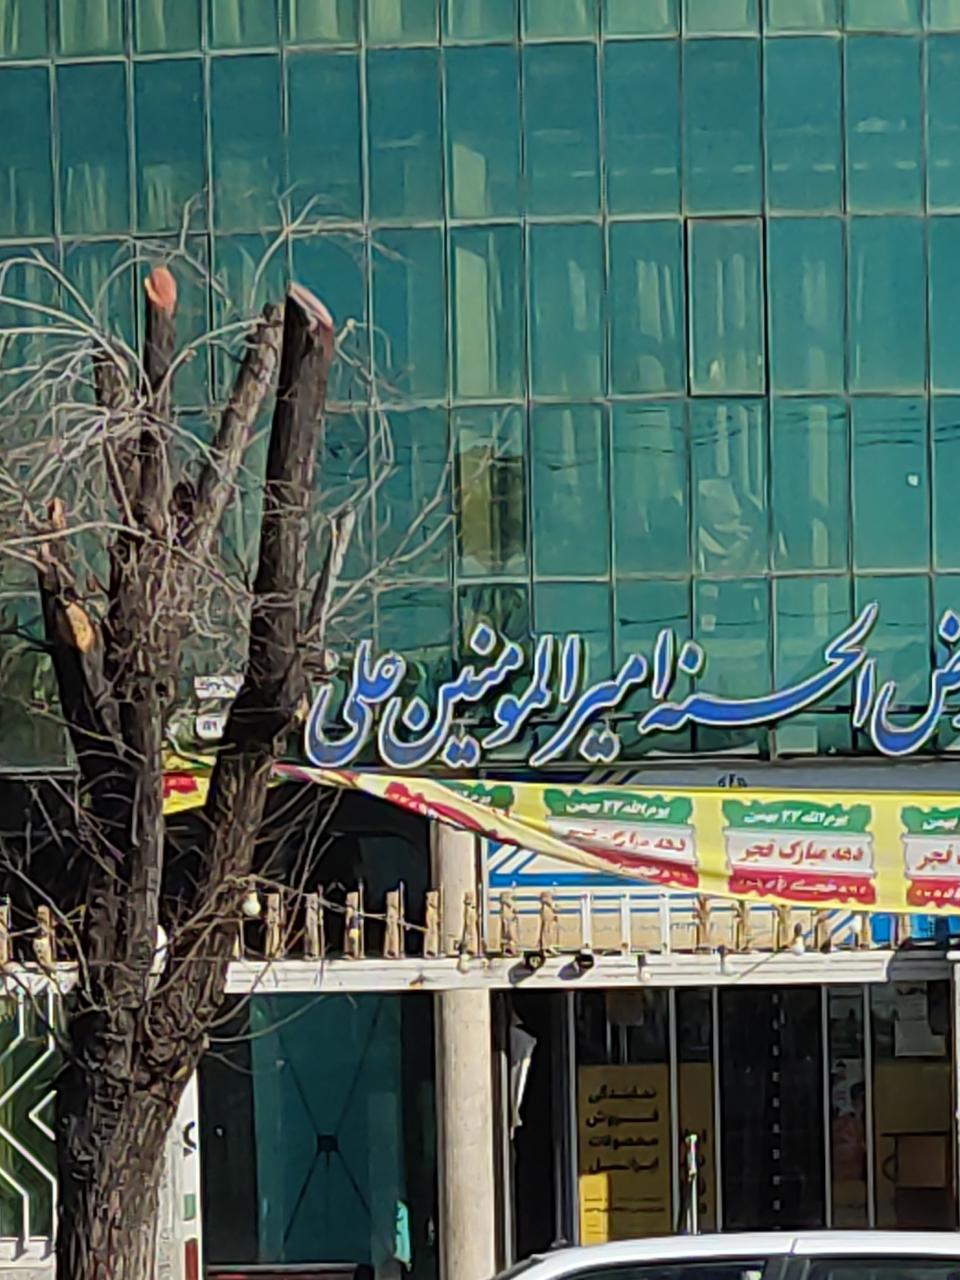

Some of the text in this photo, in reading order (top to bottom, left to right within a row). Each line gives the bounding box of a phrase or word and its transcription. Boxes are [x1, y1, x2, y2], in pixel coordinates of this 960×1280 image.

[304, 637, 407, 767] علی
[922, 818, 958, 830] بهمن
[738, 838, 864, 865] دهه مبارک فجر
[916, 843, 953, 870] فجر
